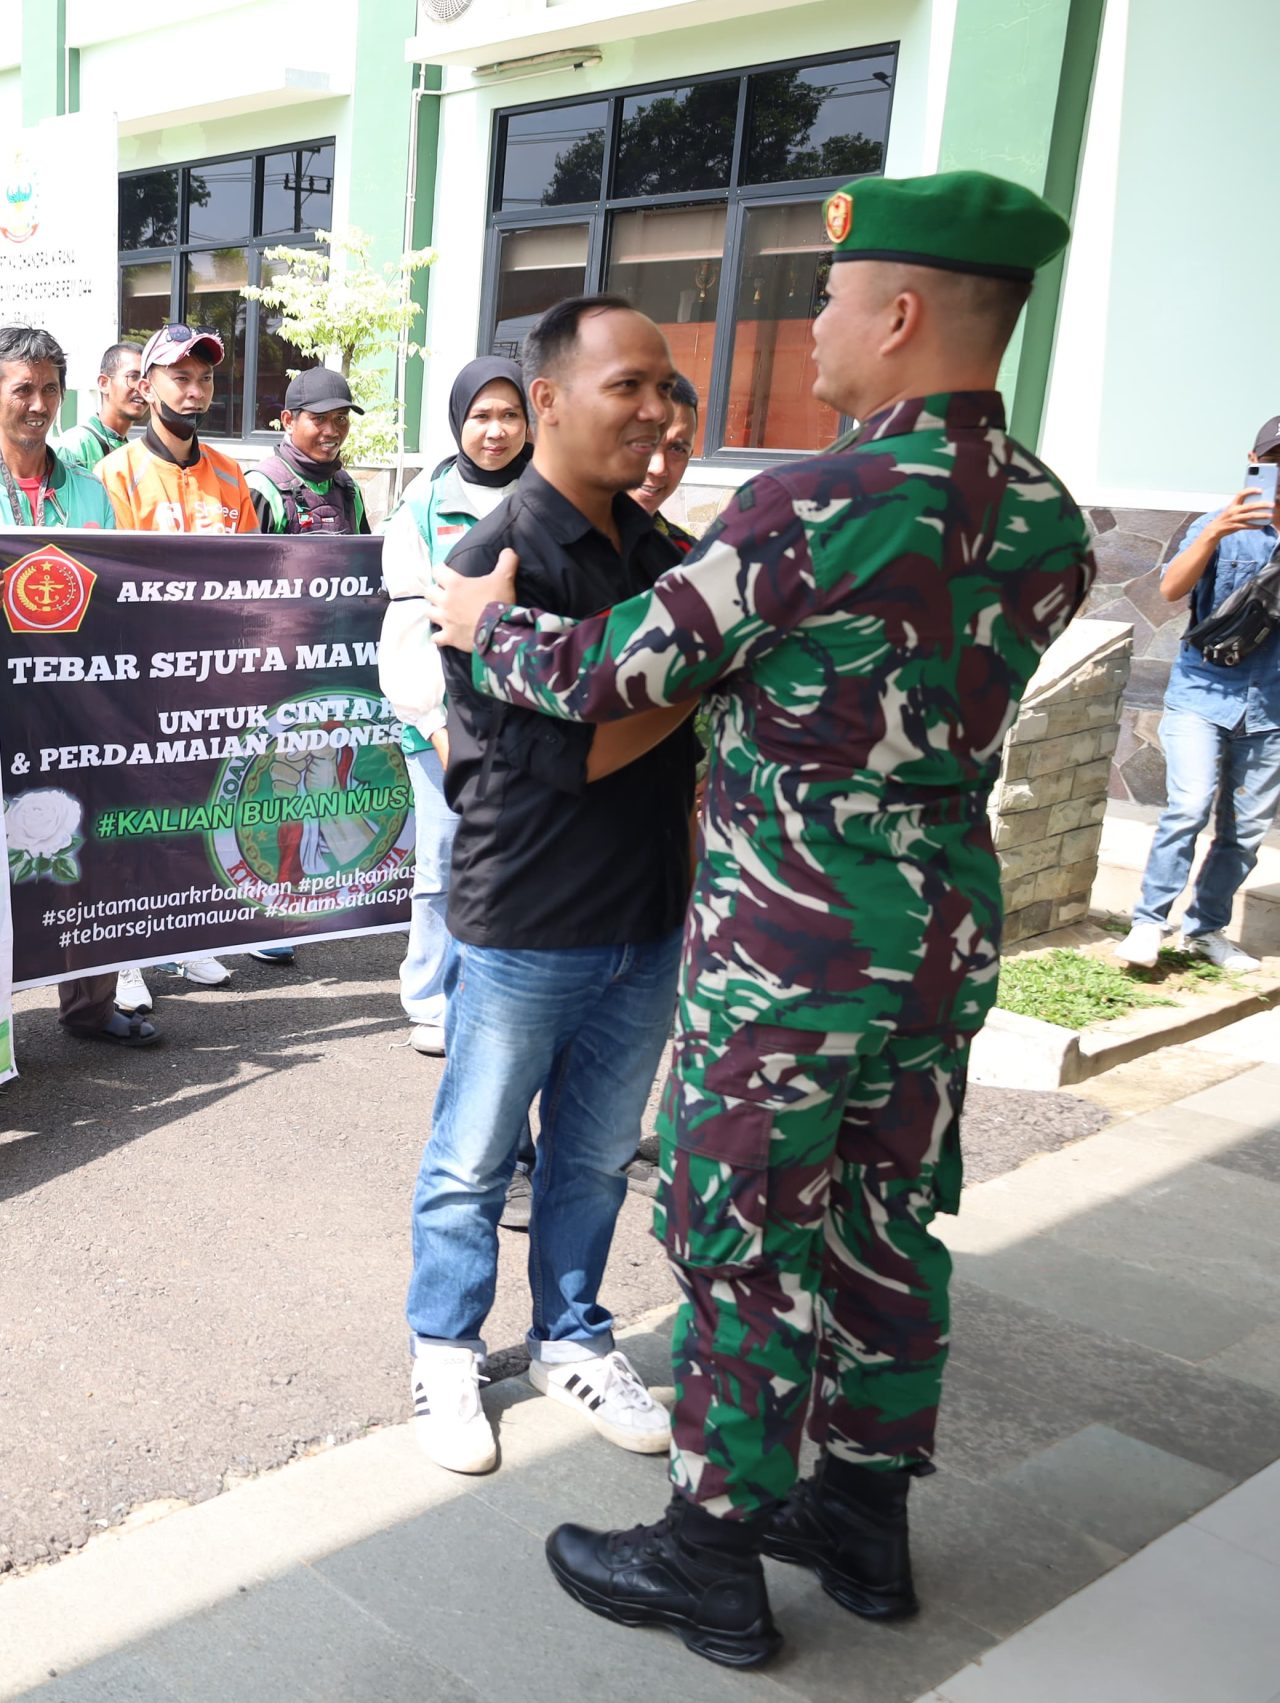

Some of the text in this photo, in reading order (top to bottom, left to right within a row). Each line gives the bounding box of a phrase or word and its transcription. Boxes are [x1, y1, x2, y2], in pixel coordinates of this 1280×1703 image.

[117, 580, 197, 602] AKSI
[201, 579, 303, 601] DAMAI
[309, 576, 374, 601] OJOL
[8, 654, 140, 684] TEBAR
[149, 647, 287, 683] SEJUTA
[158, 704, 269, 734] UNTUK
[276, 698, 370, 726] CINTA
[10, 752, 31, 775] &
[40, 734, 269, 772] PERDAMAIAN
[97, 802, 235, 839] #KALIAN
[242, 791, 339, 827] BUKAN
[58, 905, 259, 948] #tebarsejutamawar
